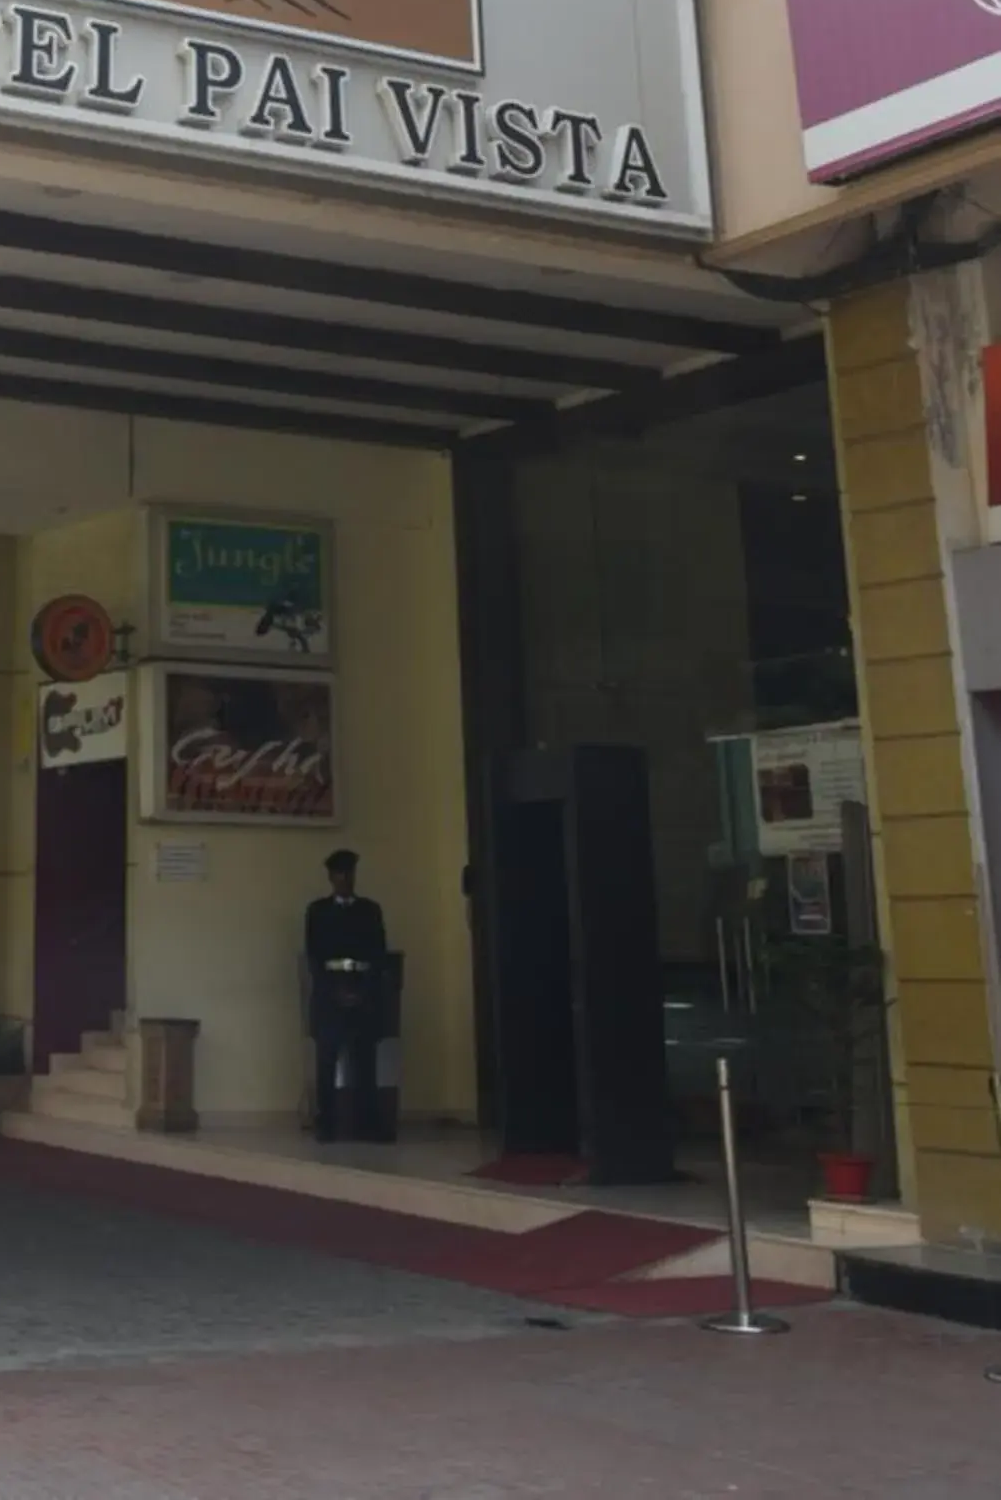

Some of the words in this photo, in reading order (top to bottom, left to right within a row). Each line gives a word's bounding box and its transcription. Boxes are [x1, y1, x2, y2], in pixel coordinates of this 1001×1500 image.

[183, 38, 353, 146] PAI
[386, 77, 669, 203] VISTA
[174, 527, 315, 587] Jungle
